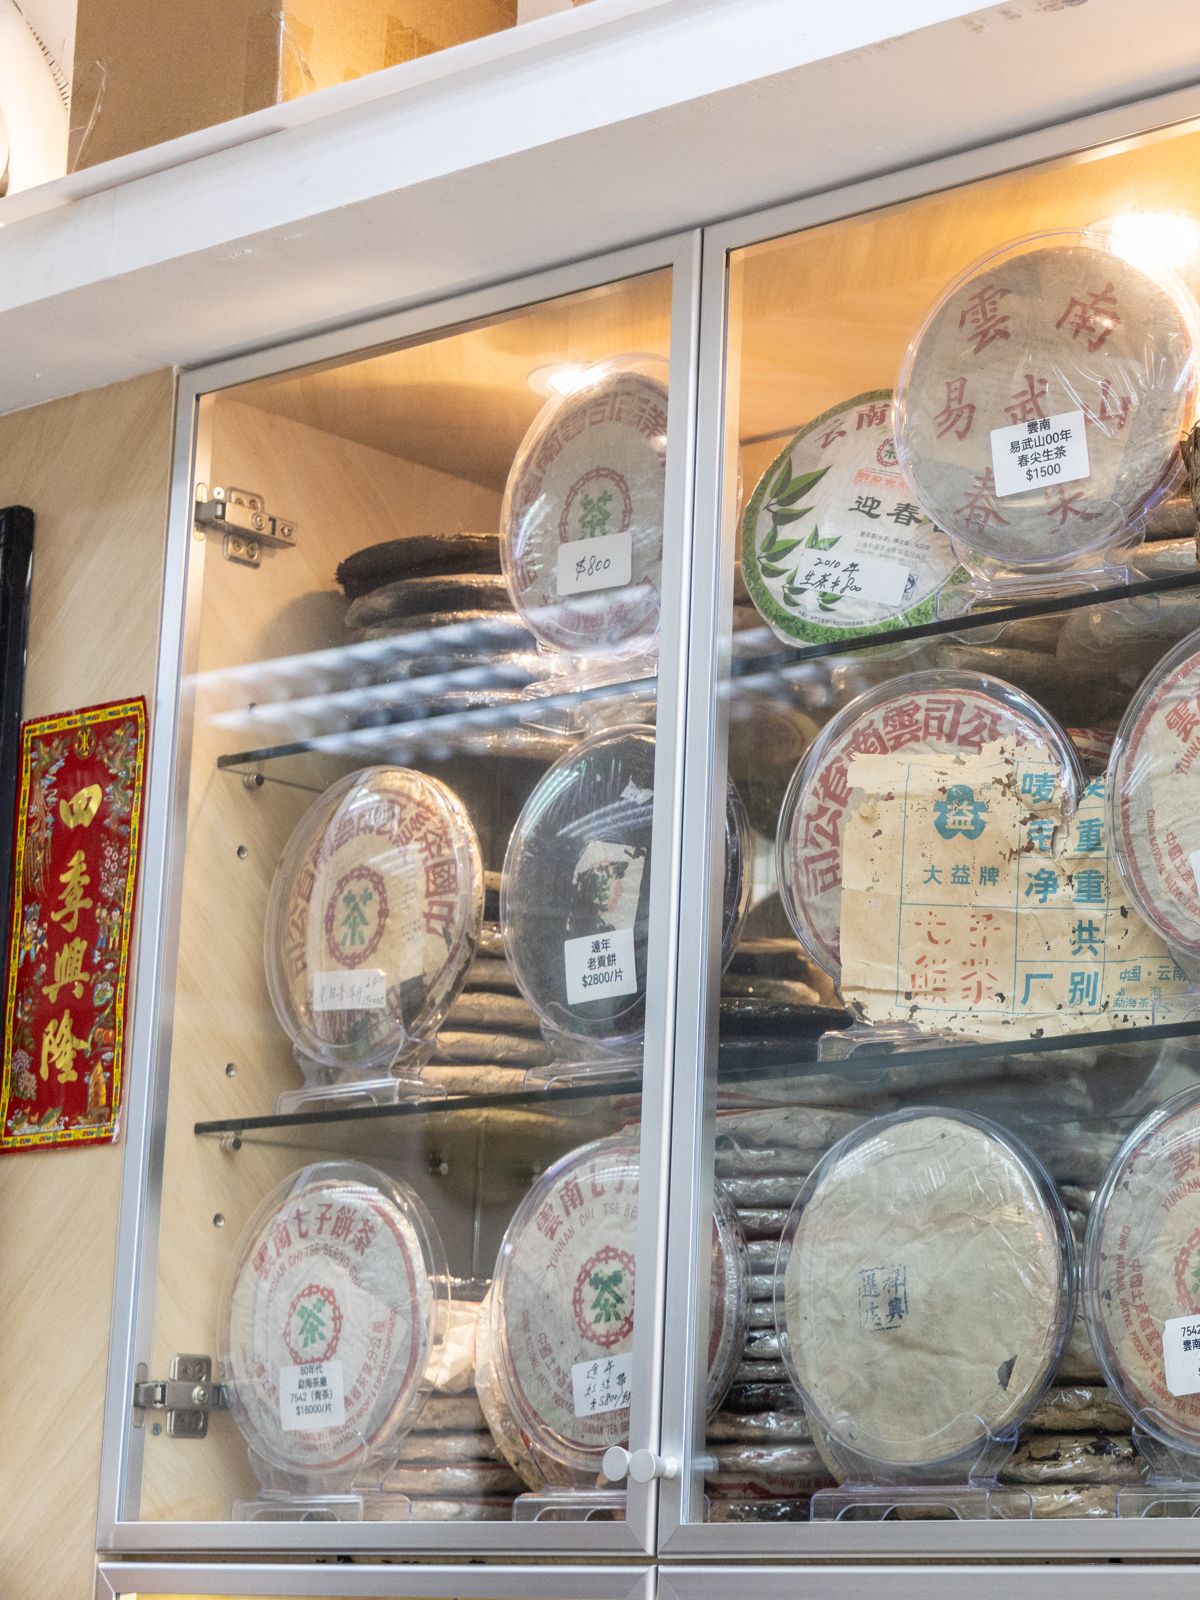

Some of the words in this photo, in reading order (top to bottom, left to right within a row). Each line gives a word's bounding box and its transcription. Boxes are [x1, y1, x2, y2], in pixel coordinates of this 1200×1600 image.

[1027, 418, 1051, 434] 雲南
[1009, 430, 1072, 455] 易武山00年
[1017, 446, 1067, 468] 春尖生茶
[1025, 464, 1062, 482] $1500
[848, 496, 947, 534] 迎春
[575, 557, 612, 581] $800
[923, 864, 1000, 887] 大益牌
[1025, 867, 1105, 904] 净重
[40, 783, 103, 1084] 四季興隆
[1072, 919, 1101, 957] 共
[581, 967, 623, 989] $2800/片
[1020, 971, 1099, 1007] 厂别
